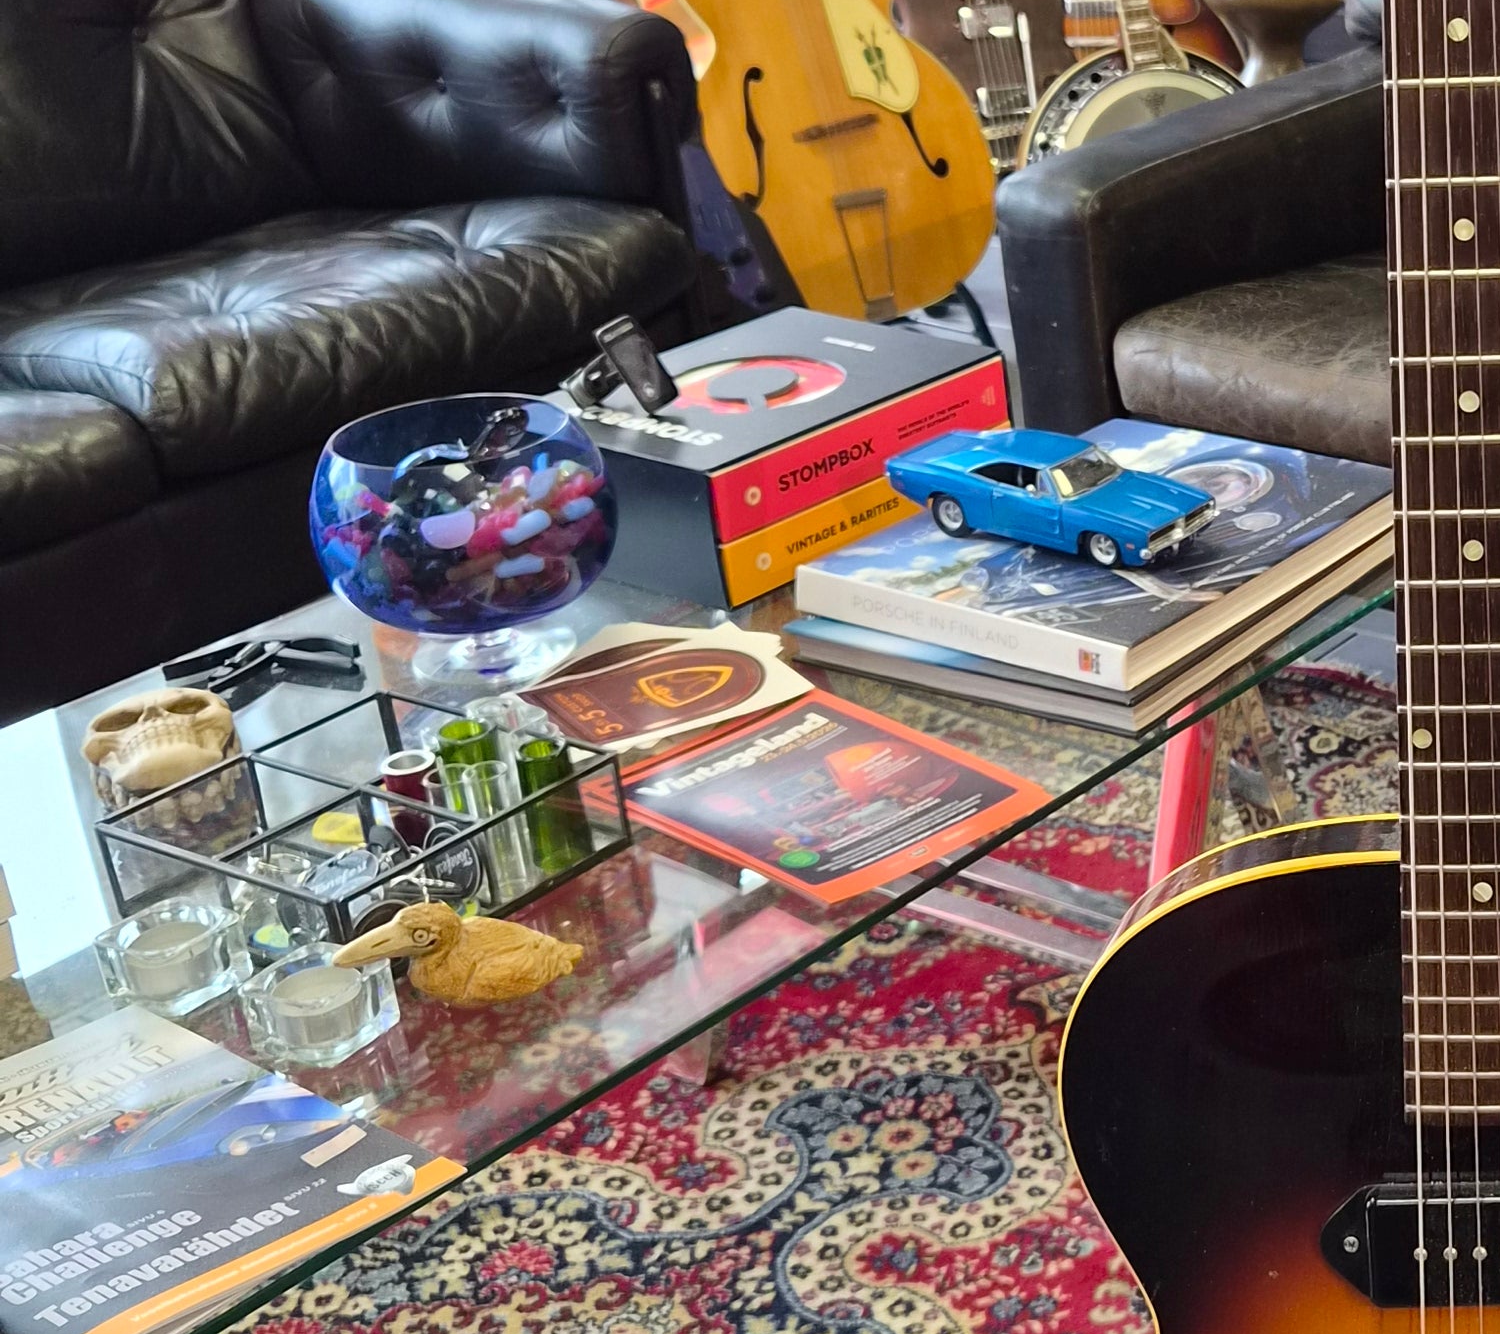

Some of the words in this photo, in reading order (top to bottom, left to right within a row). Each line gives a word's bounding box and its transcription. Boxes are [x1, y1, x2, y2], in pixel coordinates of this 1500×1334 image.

[778, 438, 876, 492] STOMPBOX
[786, 525, 837, 555] VINTAGE
[839, 520, 848, 532] &
[850, 497, 900, 527] RARITIES
[853, 593, 927, 627] PORSCHE
[929, 616, 945, 631] IN
[950, 620, 1019, 650] FINLAND
[636, 712, 829, 797] Vintageland
[0, 1045, 174, 1135] RENAULT
[283, 1185, 311, 1202] SIVU
[1, 1209, 202, 1306] Challenge
[33, 1201, 300, 1328] Tenavatähdet
